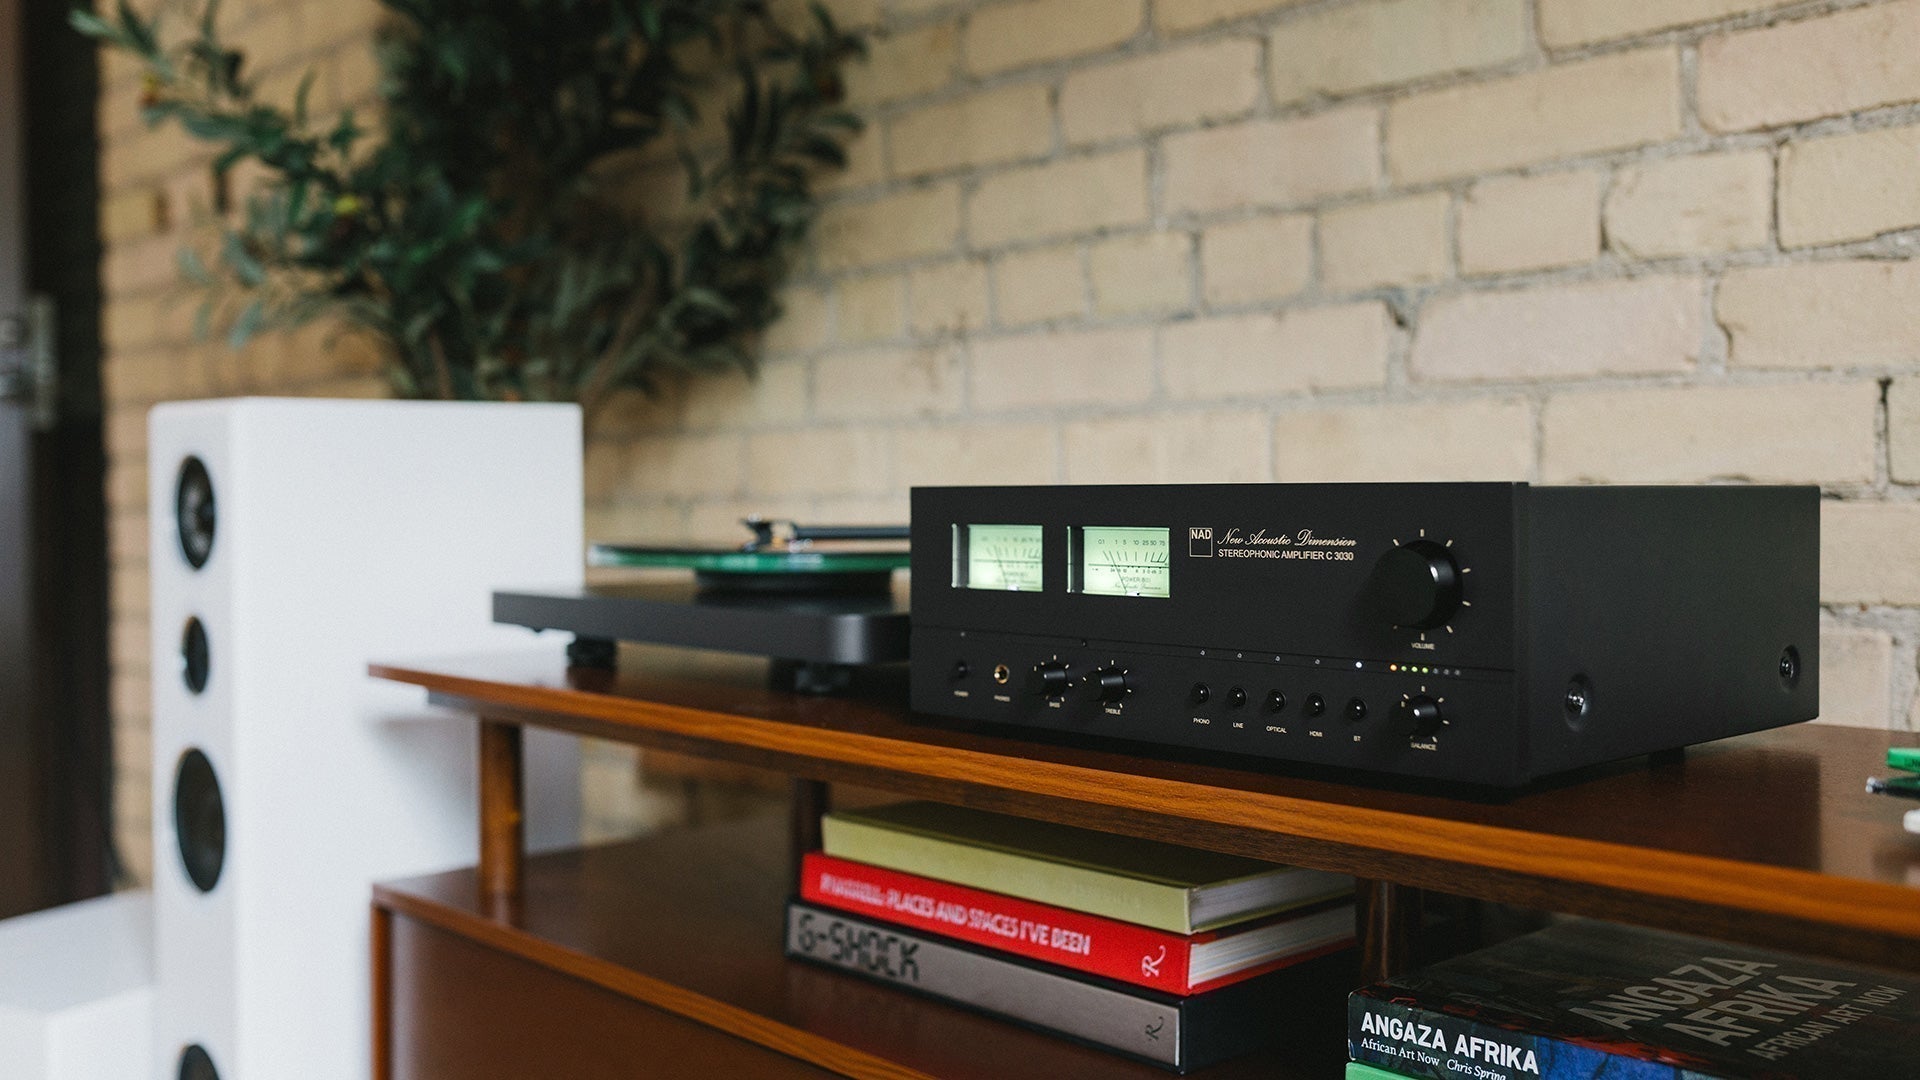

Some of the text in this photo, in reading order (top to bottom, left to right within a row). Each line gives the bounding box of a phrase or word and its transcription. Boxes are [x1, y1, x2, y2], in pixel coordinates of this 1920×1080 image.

[1191, 529, 1212, 540] NAD
[1217, 528, 1357, 547] New Acoustic Dimension
[1218, 548, 1354, 561] STEREOPHONIC AMPLIFIER C 3030
[1411, 642, 1435, 650] VOLUME
[1193, 717, 1210, 725] PHONO
[1266, 725, 1287, 734] OPTICAL
[1410, 742, 1437, 751] BALANCE
[887, 888, 935, 919] PLACES
[934, 900, 969, 926] AND
[967, 907, 1019, 938] SPACES
[1019, 920, 1049, 948] I'VE
[1051, 926, 1091, 956] BEEN
[799, 913, 920, 981] G-SHOCK
[1568, 956, 1778, 1031] ANGAZA
[1663, 974, 1858, 1047] AFRIKA
[1747, 984, 1908, 1061] AFRICAN ART NOW
[1361, 1011, 1539, 1075] ANGAZA AFRIKA
[1361, 1037, 1440, 1067] African Art Now
[1446, 1059, 1507, 1080] Chris Spring
